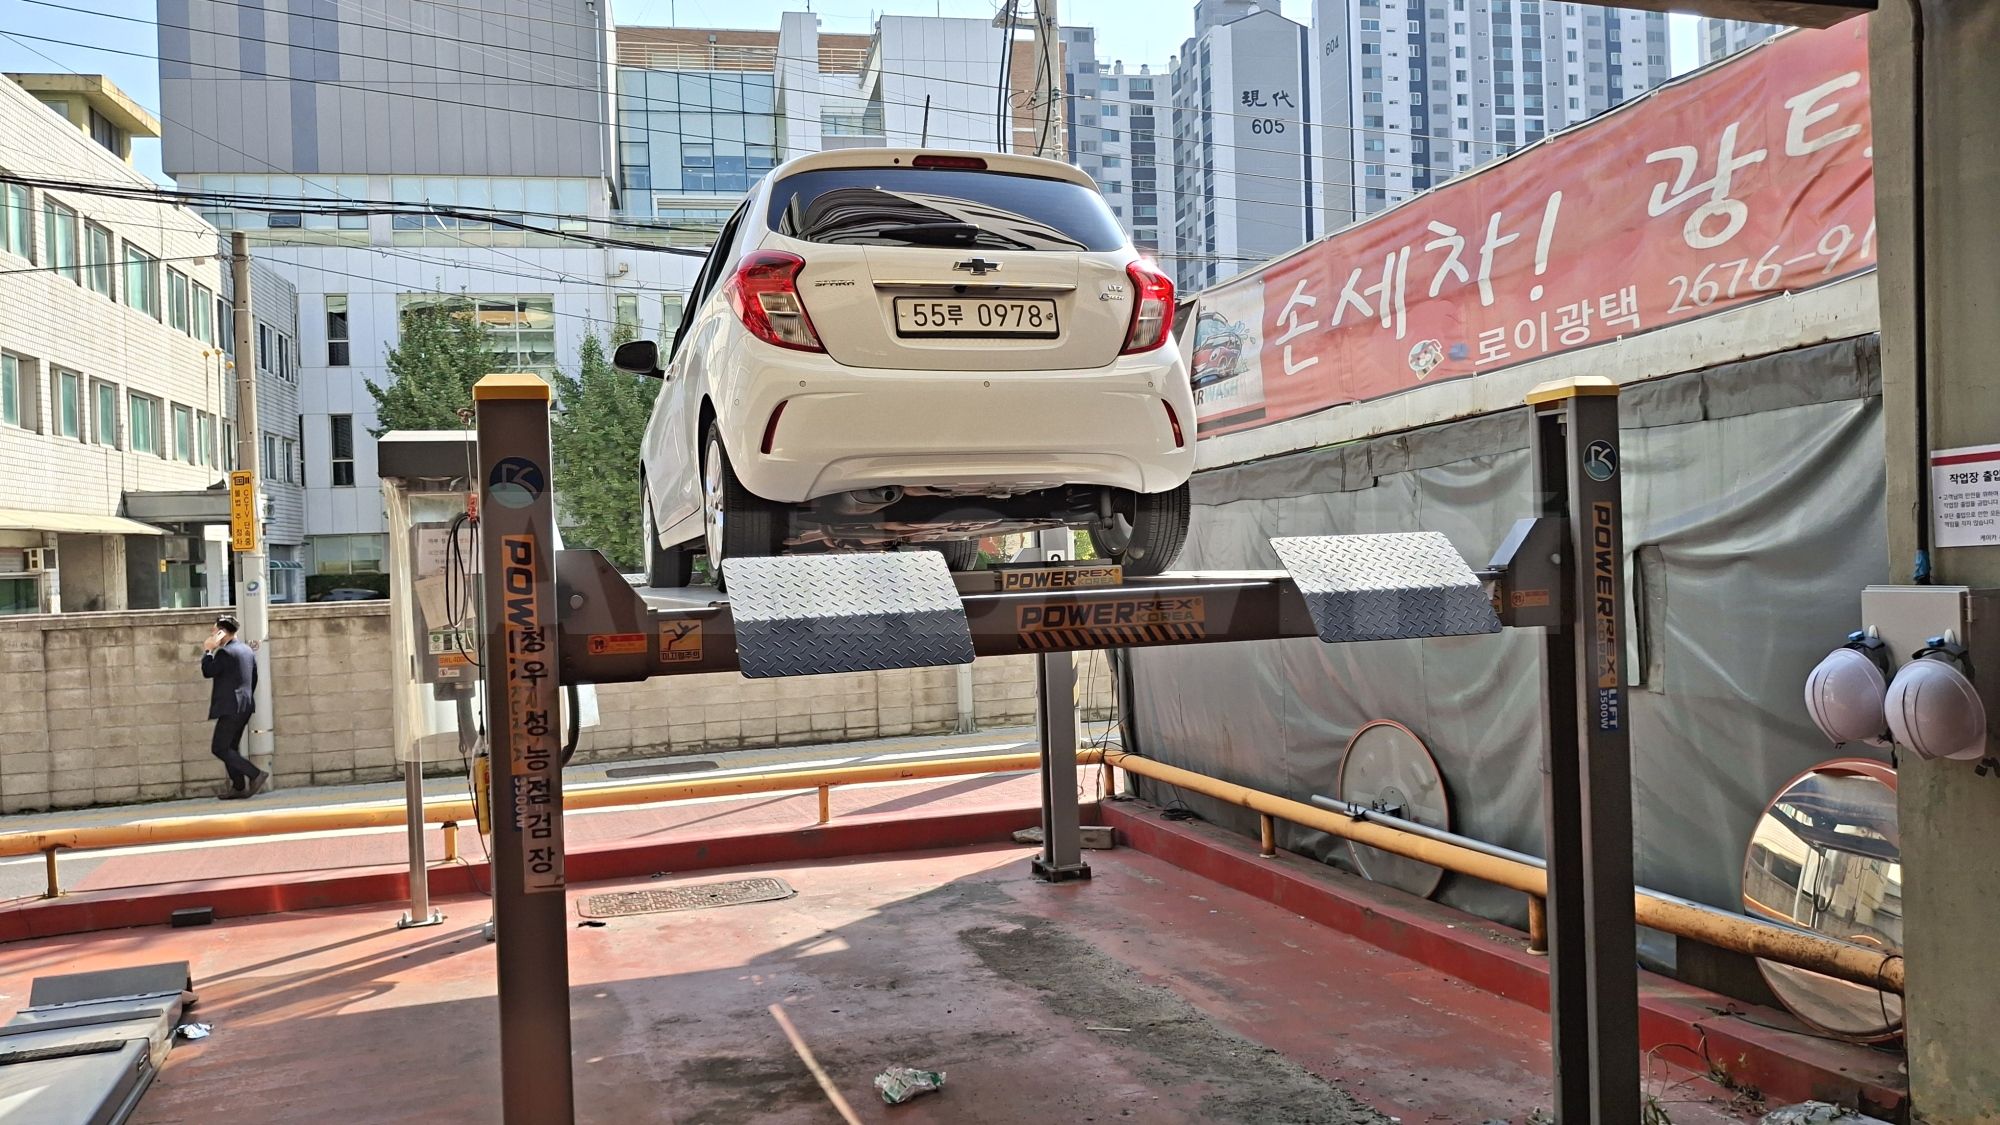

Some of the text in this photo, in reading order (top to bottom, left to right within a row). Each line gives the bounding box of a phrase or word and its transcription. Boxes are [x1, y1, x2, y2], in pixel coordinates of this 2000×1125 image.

[1325, 35, 1339, 56] 604
[1241, 89, 1295, 108] 現代
[1251, 118, 1285, 135] 605
[1275, 190, 1563, 376] 손세차!
[914, 303, 1043, 328] 55루 0978
[1474, 284, 1642, 366] 로이광택
[1949, 472, 1979, 484] 작업장
[1136, 611, 1195, 623] KOREA
[1600, 690, 1609, 729] 3500W
[1608, 688, 1618, 729] LIFT
